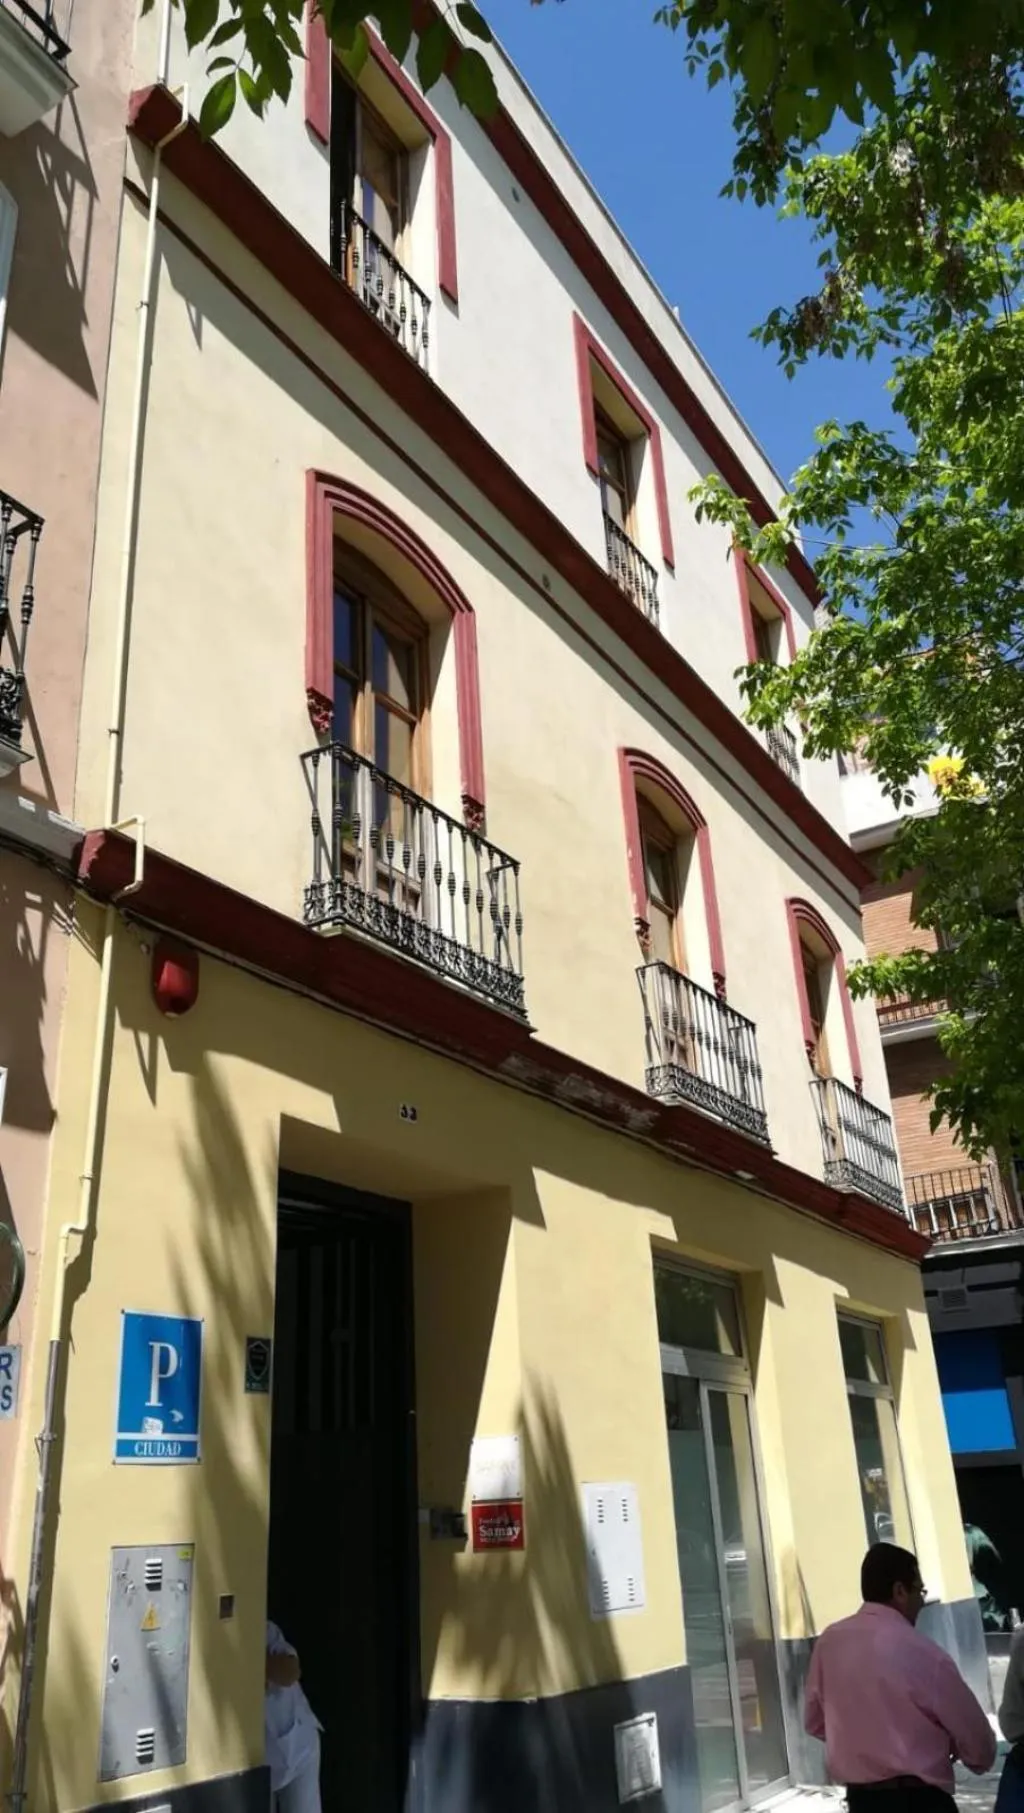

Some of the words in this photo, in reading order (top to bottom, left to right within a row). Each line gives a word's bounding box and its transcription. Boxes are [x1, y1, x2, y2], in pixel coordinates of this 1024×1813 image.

[145, 1341, 178, 1407] P
[134, 1440, 181, 1456] CIUDAD
[479, 1525, 520, 1541] Samay
